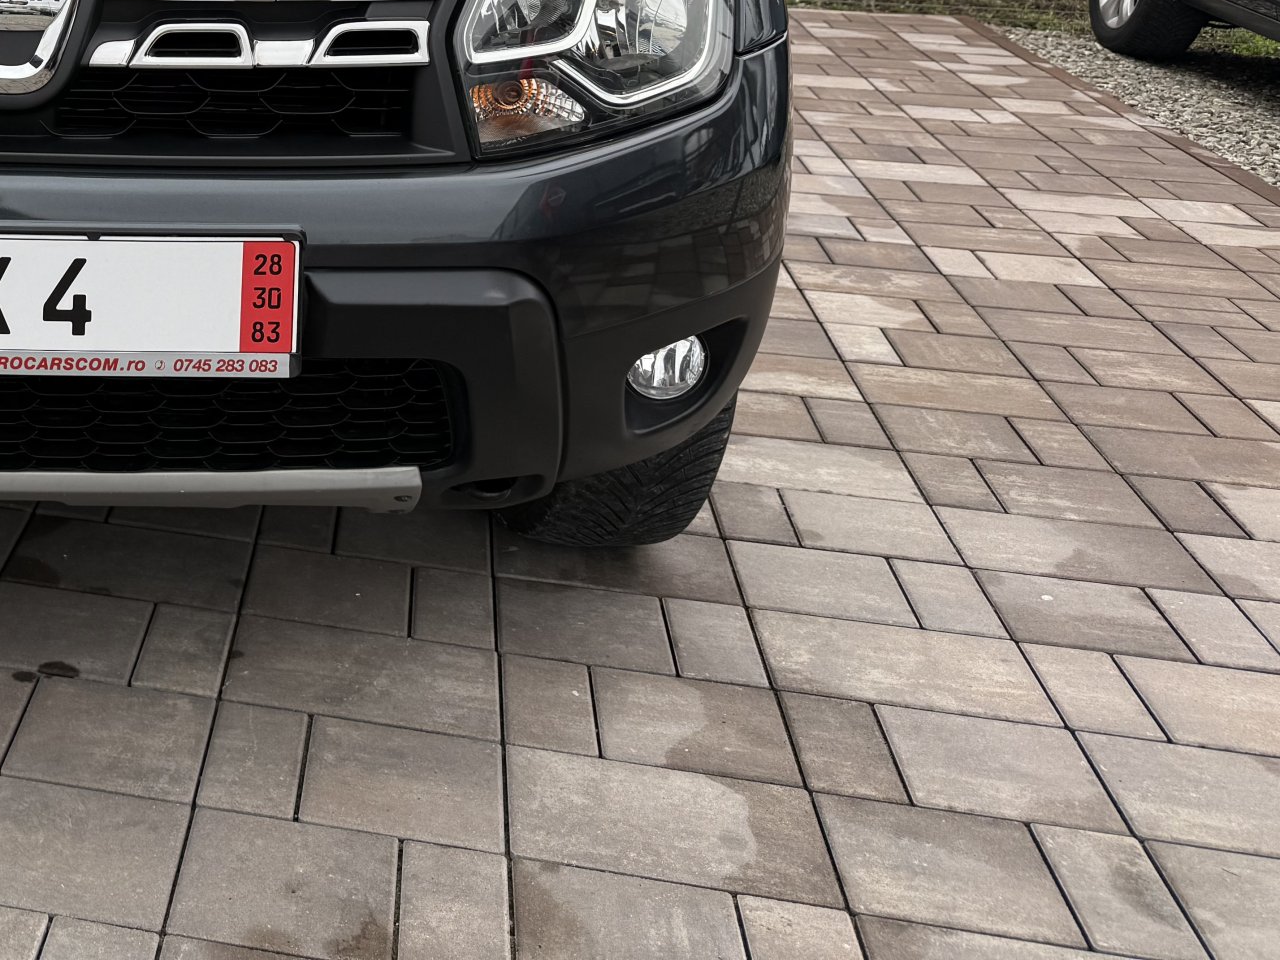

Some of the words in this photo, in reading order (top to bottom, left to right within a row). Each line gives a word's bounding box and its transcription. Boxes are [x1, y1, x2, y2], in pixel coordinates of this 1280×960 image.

[253, 253, 282, 276] 28
[42, 258, 92, 336] 4
[252, 286, 282, 309] 30
[251, 321, 280, 343] 83
[173, 358, 211, 373] 0745
[215, 359, 244, 373] 283
[249, 359, 278, 373] 083
